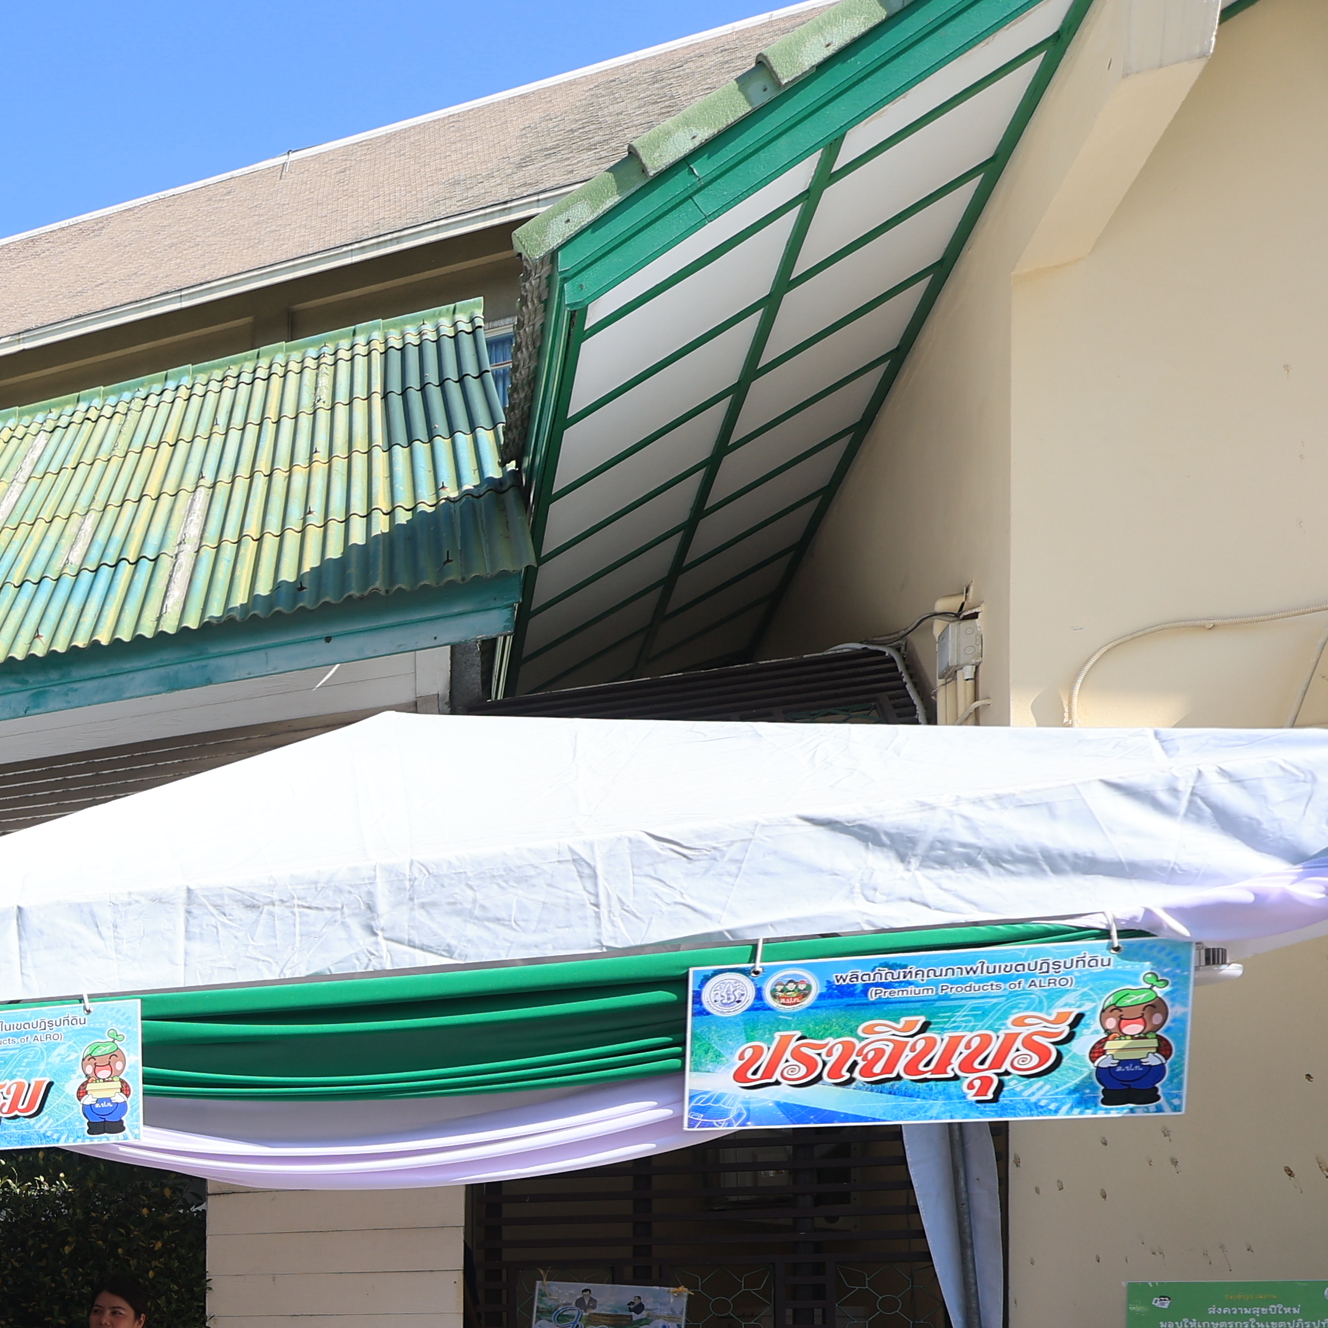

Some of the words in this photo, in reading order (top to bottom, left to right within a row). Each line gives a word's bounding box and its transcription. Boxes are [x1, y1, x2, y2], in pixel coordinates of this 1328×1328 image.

[834, 953, 1112, 985] ผลิตภัณฑ์คุณภาพในเขตปฏิรูปที่ดิน
[869, 986, 934, 1000] (Premium
[940, 982, 1002, 995] Products
[1009, 980, 1022, 990] of
[1028, 976, 1074, 989] ALRO)
[20, 1035, 31, 1045] of
[33, 1032, 63, 1044] ALRO)
[731, 1012, 1080, 1100] ปราจีนบุรี
[1207, 1304, 1301, 1317] ส่งความสุขปีใหม่
